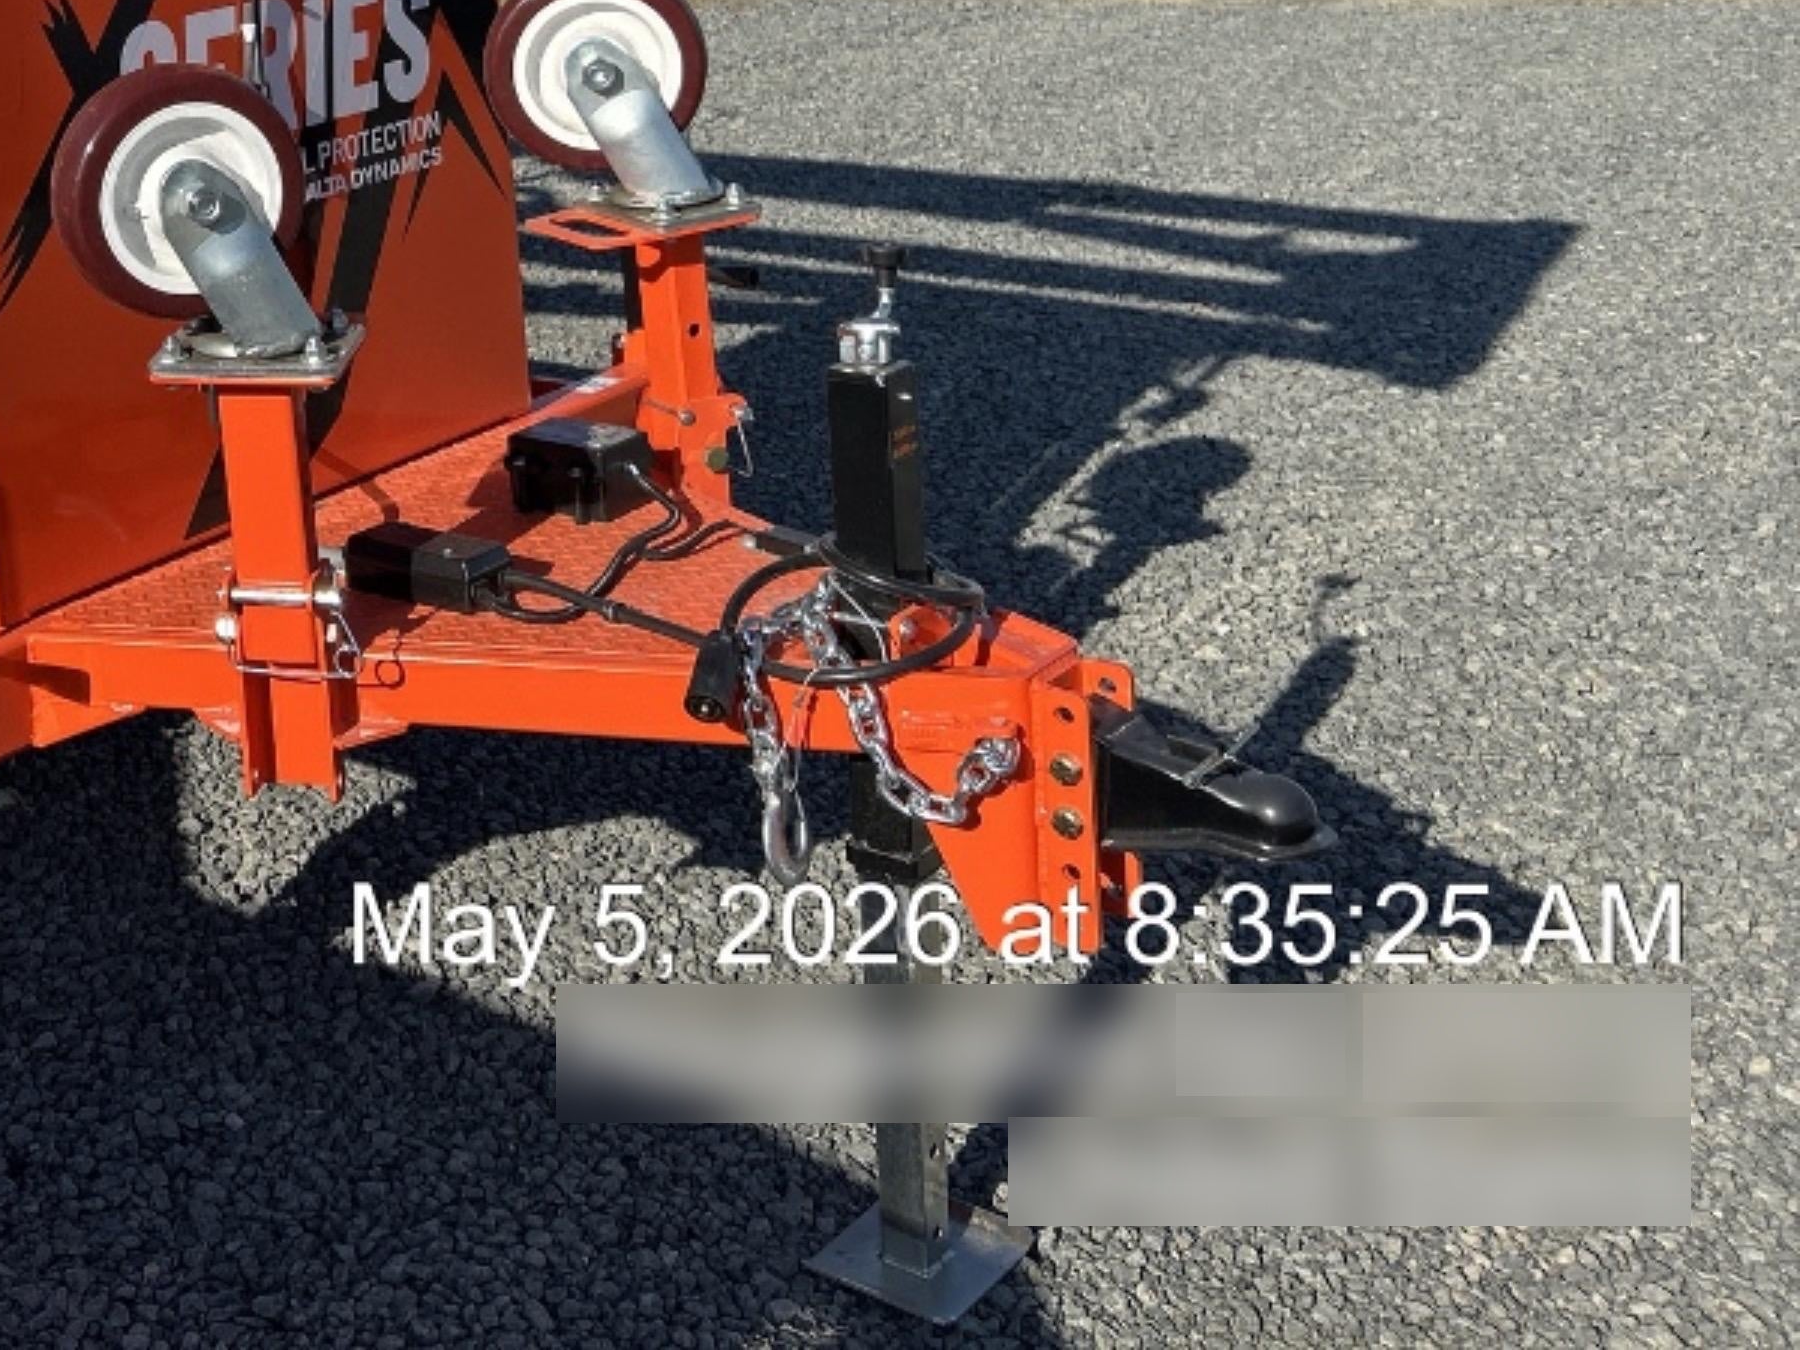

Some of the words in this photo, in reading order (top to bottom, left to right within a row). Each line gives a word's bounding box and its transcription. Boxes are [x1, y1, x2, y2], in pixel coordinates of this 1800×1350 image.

[317, 110, 442, 169] PROTECTION
[305, 171, 350, 202] ALTA
[350, 146, 443, 190] DYNAMICS
